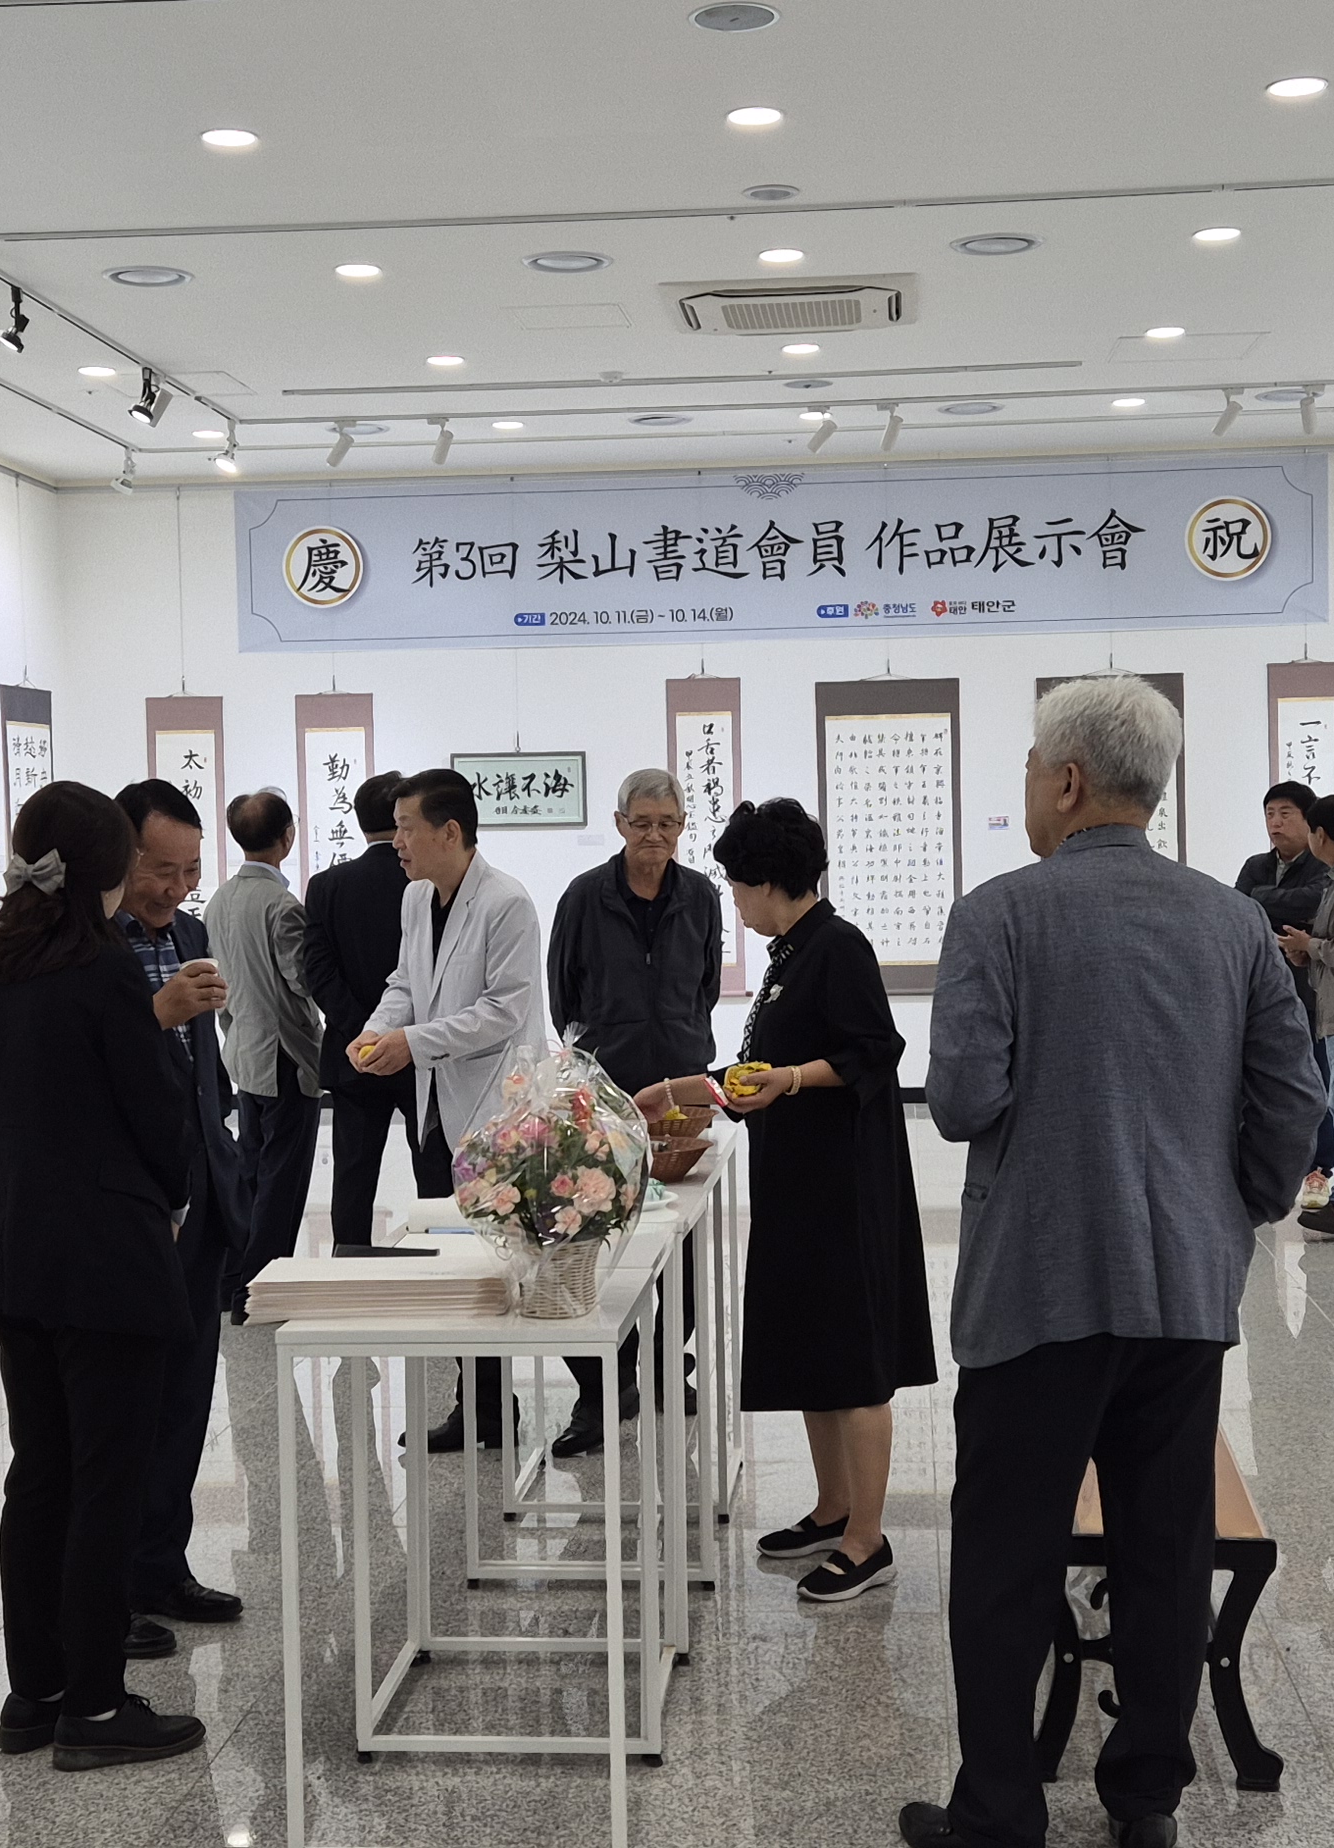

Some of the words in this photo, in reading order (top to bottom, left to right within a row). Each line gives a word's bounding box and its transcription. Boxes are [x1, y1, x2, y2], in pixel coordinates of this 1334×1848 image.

[412, 535, 519, 588] 第3回
[536, 518, 847, 586] 梨山書道會員
[865, 507, 1147, 576] 作品展示會
[1202, 517, 1261, 562] 祝
[297, 538, 351, 595] 慶
[522, 613, 542, 624] 기간
[549, 611, 590, 626] 2024.
[593, 610, 612, 625] 10.
[668, 608, 688, 623] 10.
[882, 602, 917, 614] 충청남도
[971, 599, 1016, 614] 태안군
